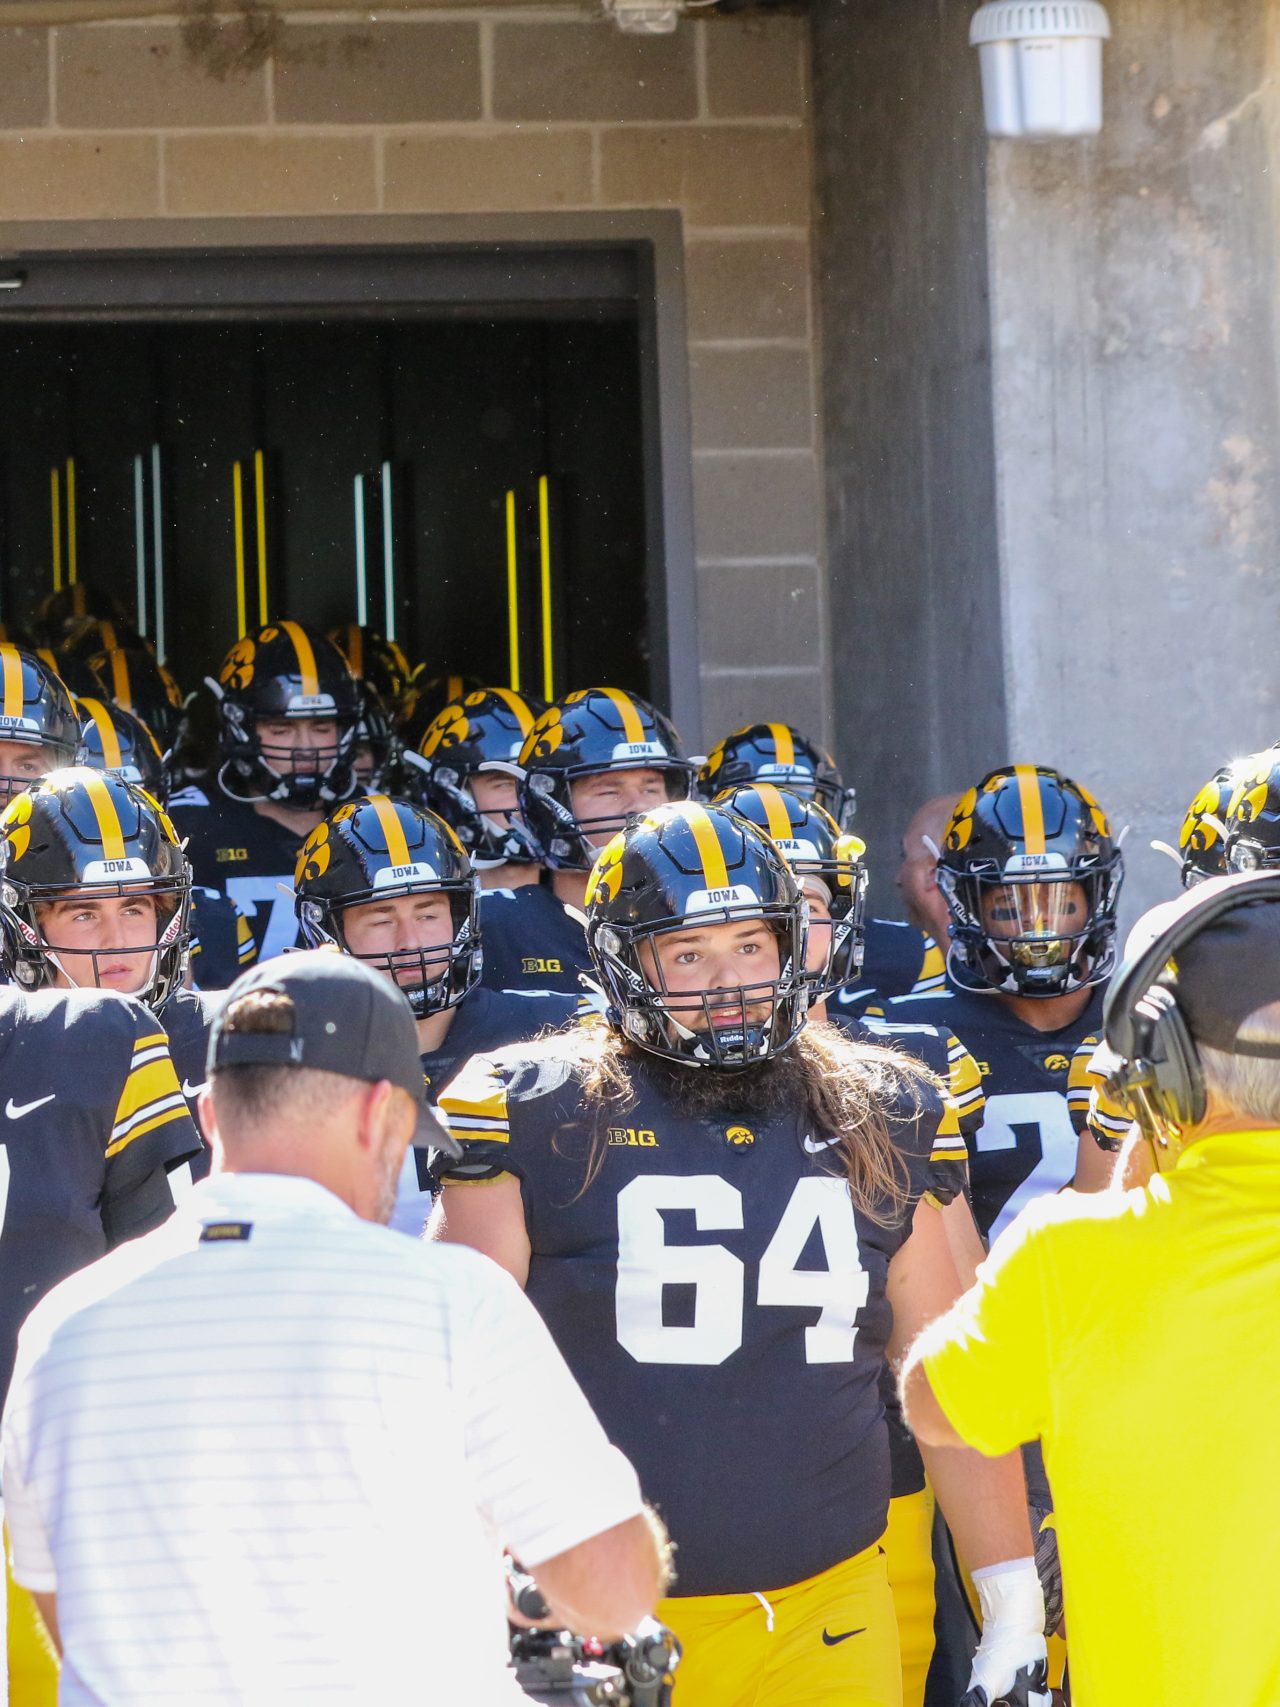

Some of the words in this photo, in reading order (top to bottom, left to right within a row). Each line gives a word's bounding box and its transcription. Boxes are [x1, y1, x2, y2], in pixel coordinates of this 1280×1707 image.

[0, 717, 25, 728] IOWA
[629, 744, 654, 755] IOWA
[104, 861, 133, 873] IOWA
[1022, 856, 1048, 867] IOWA
[392, 866, 420, 879] IOWA
[708, 889, 740, 903] IOWA
[616, 1174, 870, 1366] 64
